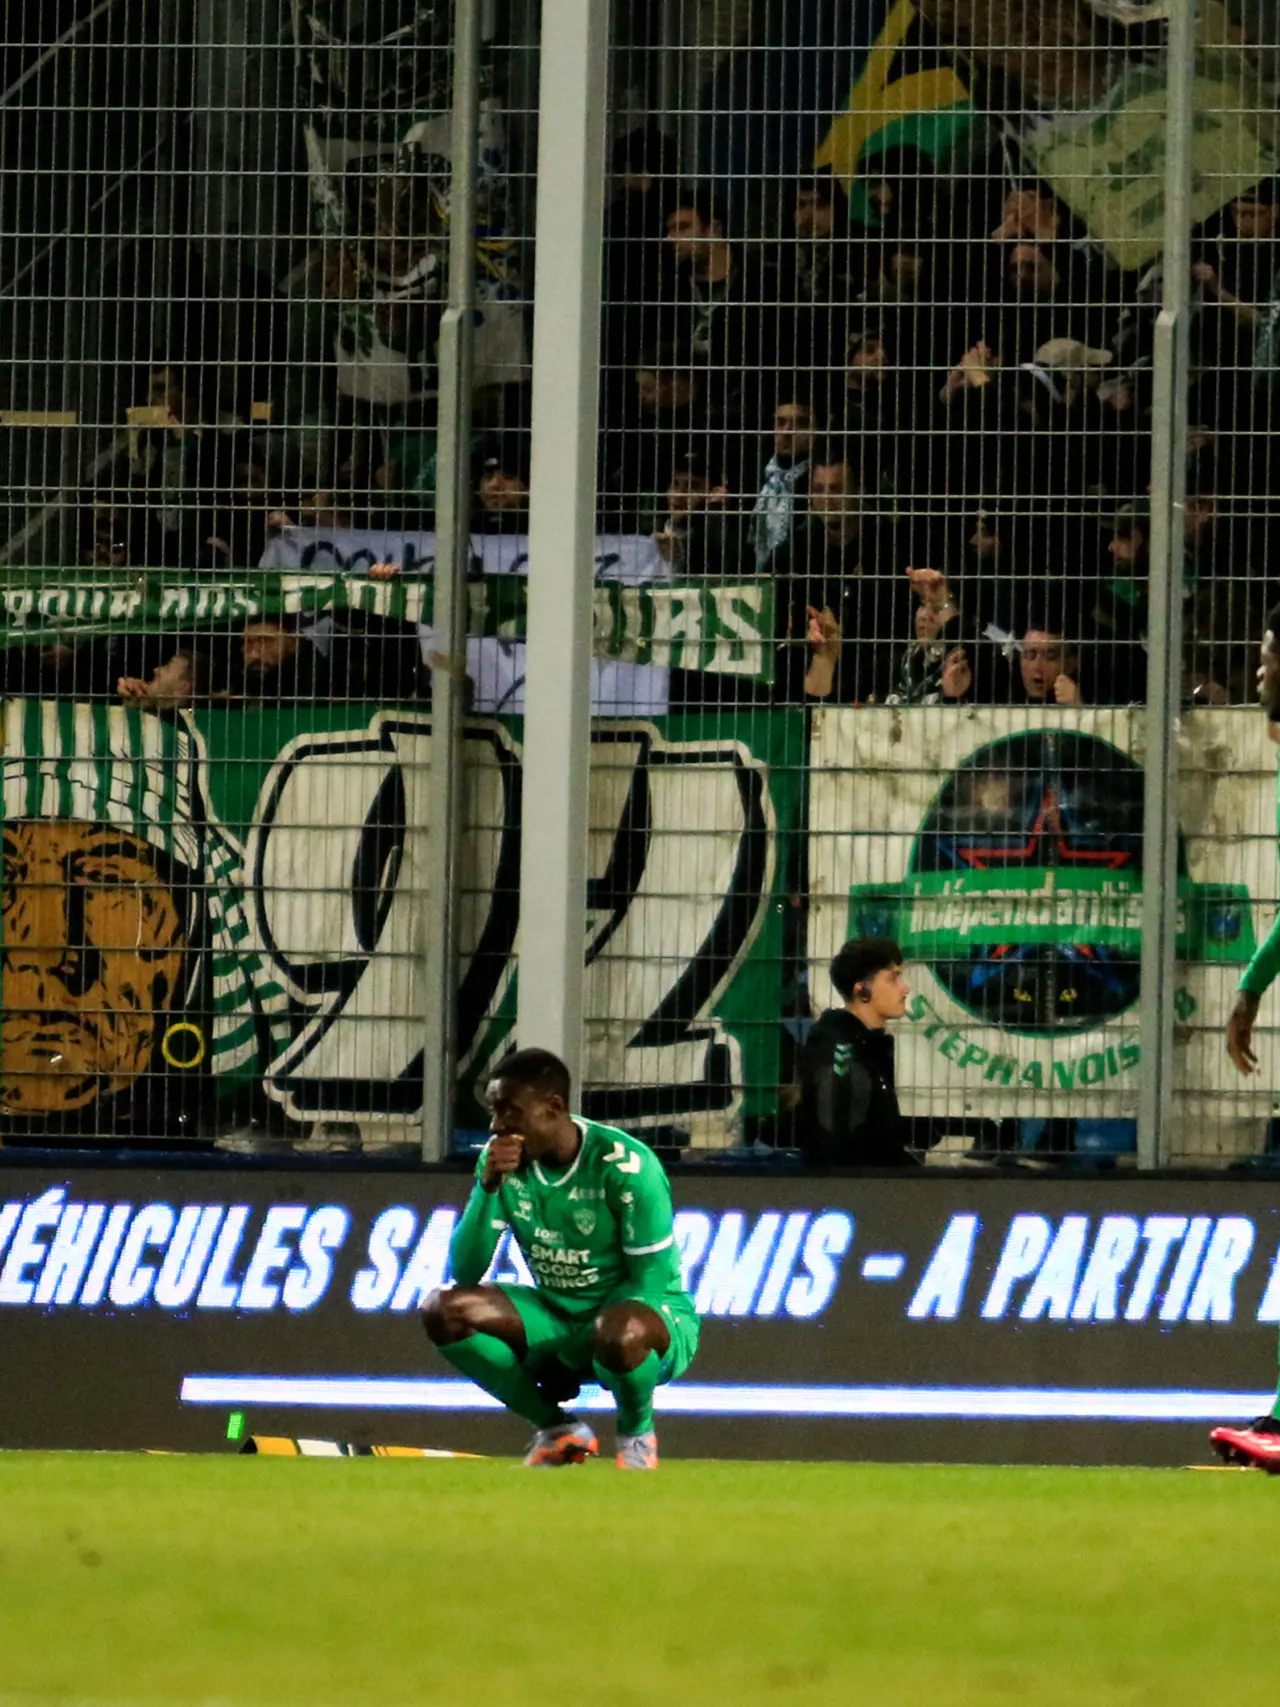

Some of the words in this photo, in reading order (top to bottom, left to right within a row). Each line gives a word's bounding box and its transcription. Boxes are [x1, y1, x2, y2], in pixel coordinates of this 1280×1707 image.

[531, 1244, 590, 1264] SMART
[670, 1209, 854, 1319] RMIS
[906, 1213, 980, 1319] A
[980, 1212, 1256, 1321] PARTIR
